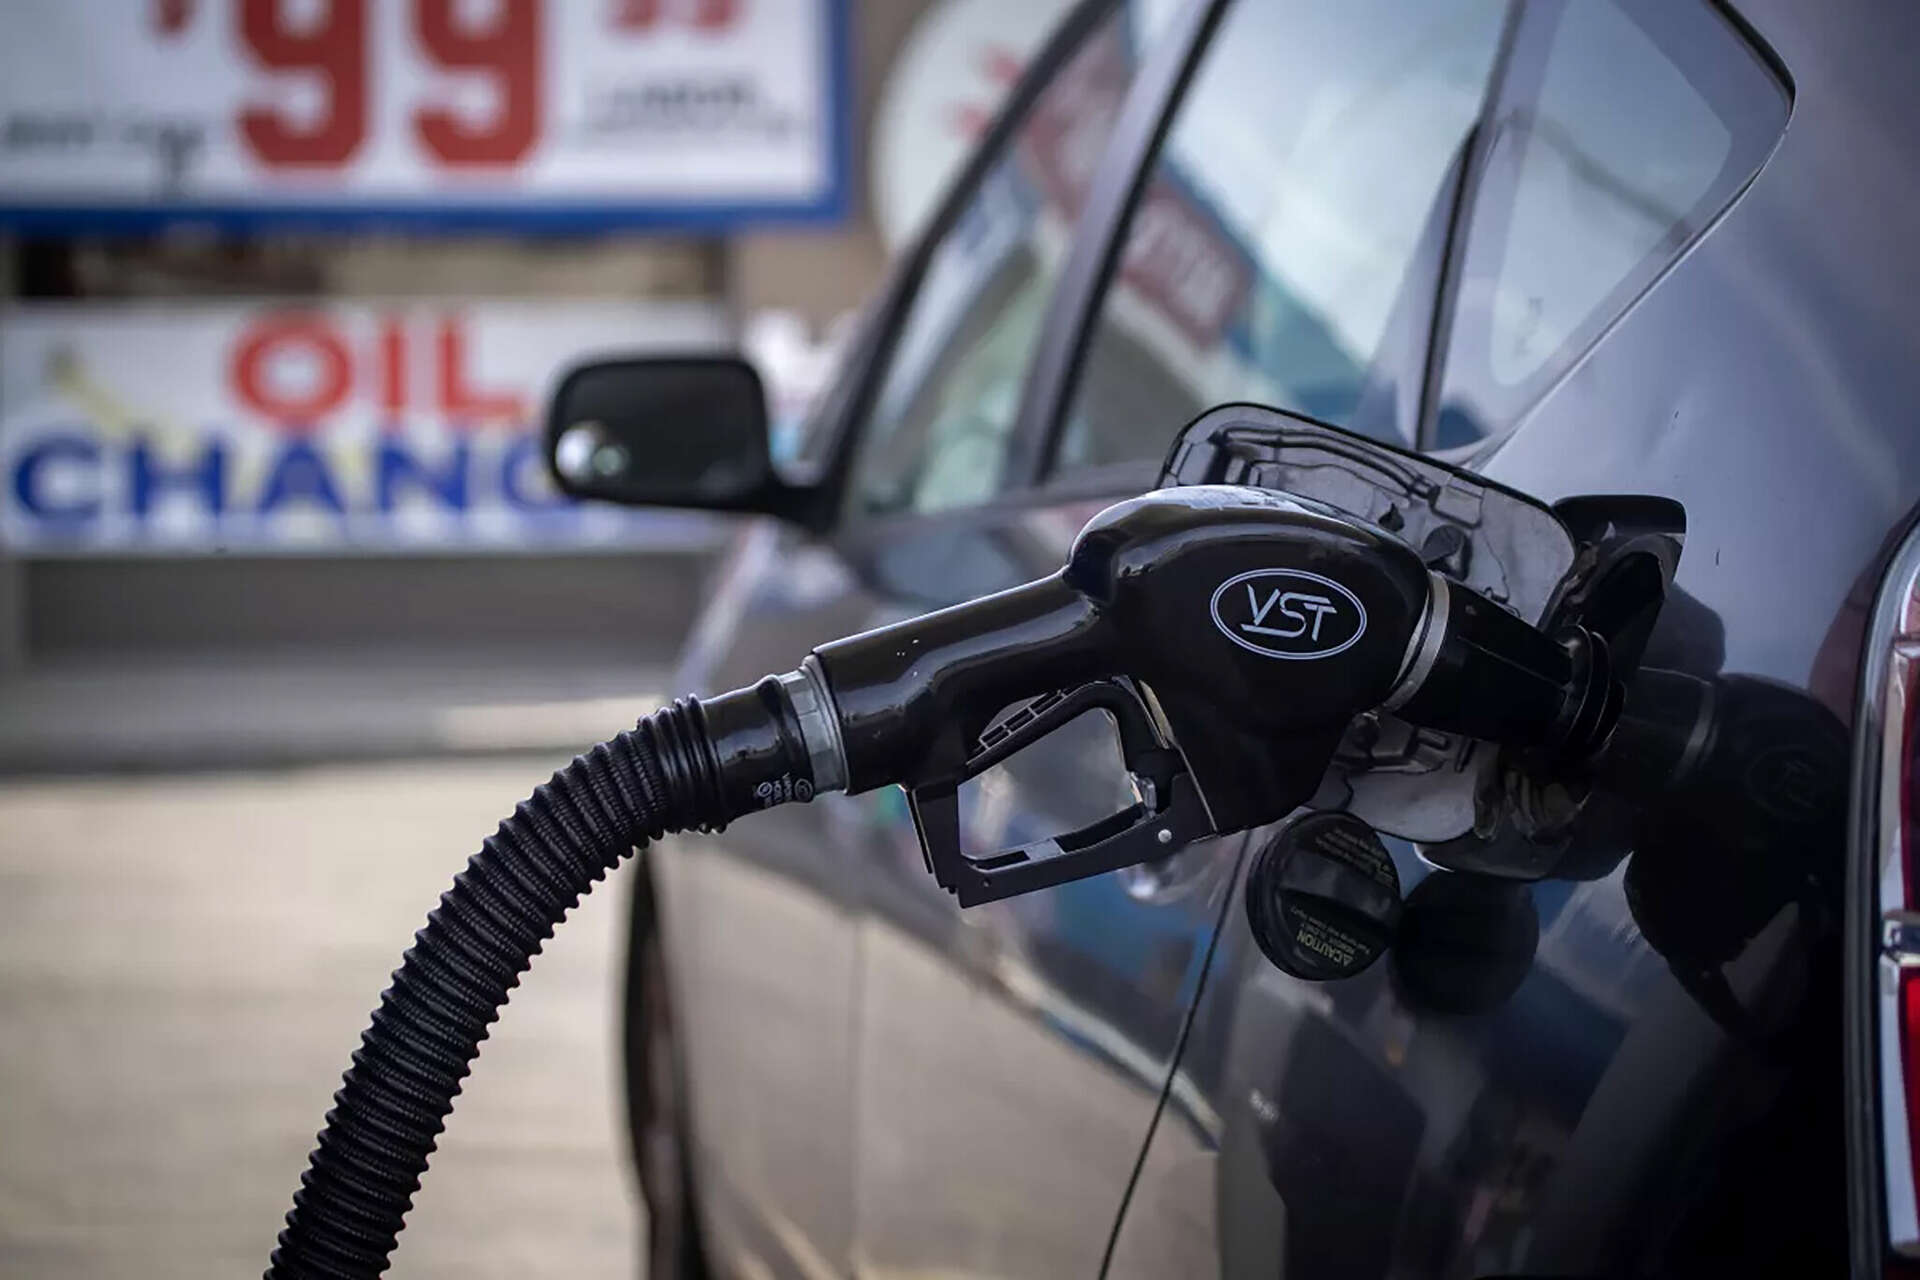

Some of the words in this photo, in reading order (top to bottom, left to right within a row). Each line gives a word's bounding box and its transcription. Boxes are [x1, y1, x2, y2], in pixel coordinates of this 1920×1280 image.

[231, 309, 526, 426] OIL
[1241, 584, 1338, 642] VST
[1297, 930, 1345, 963] CAUTION
